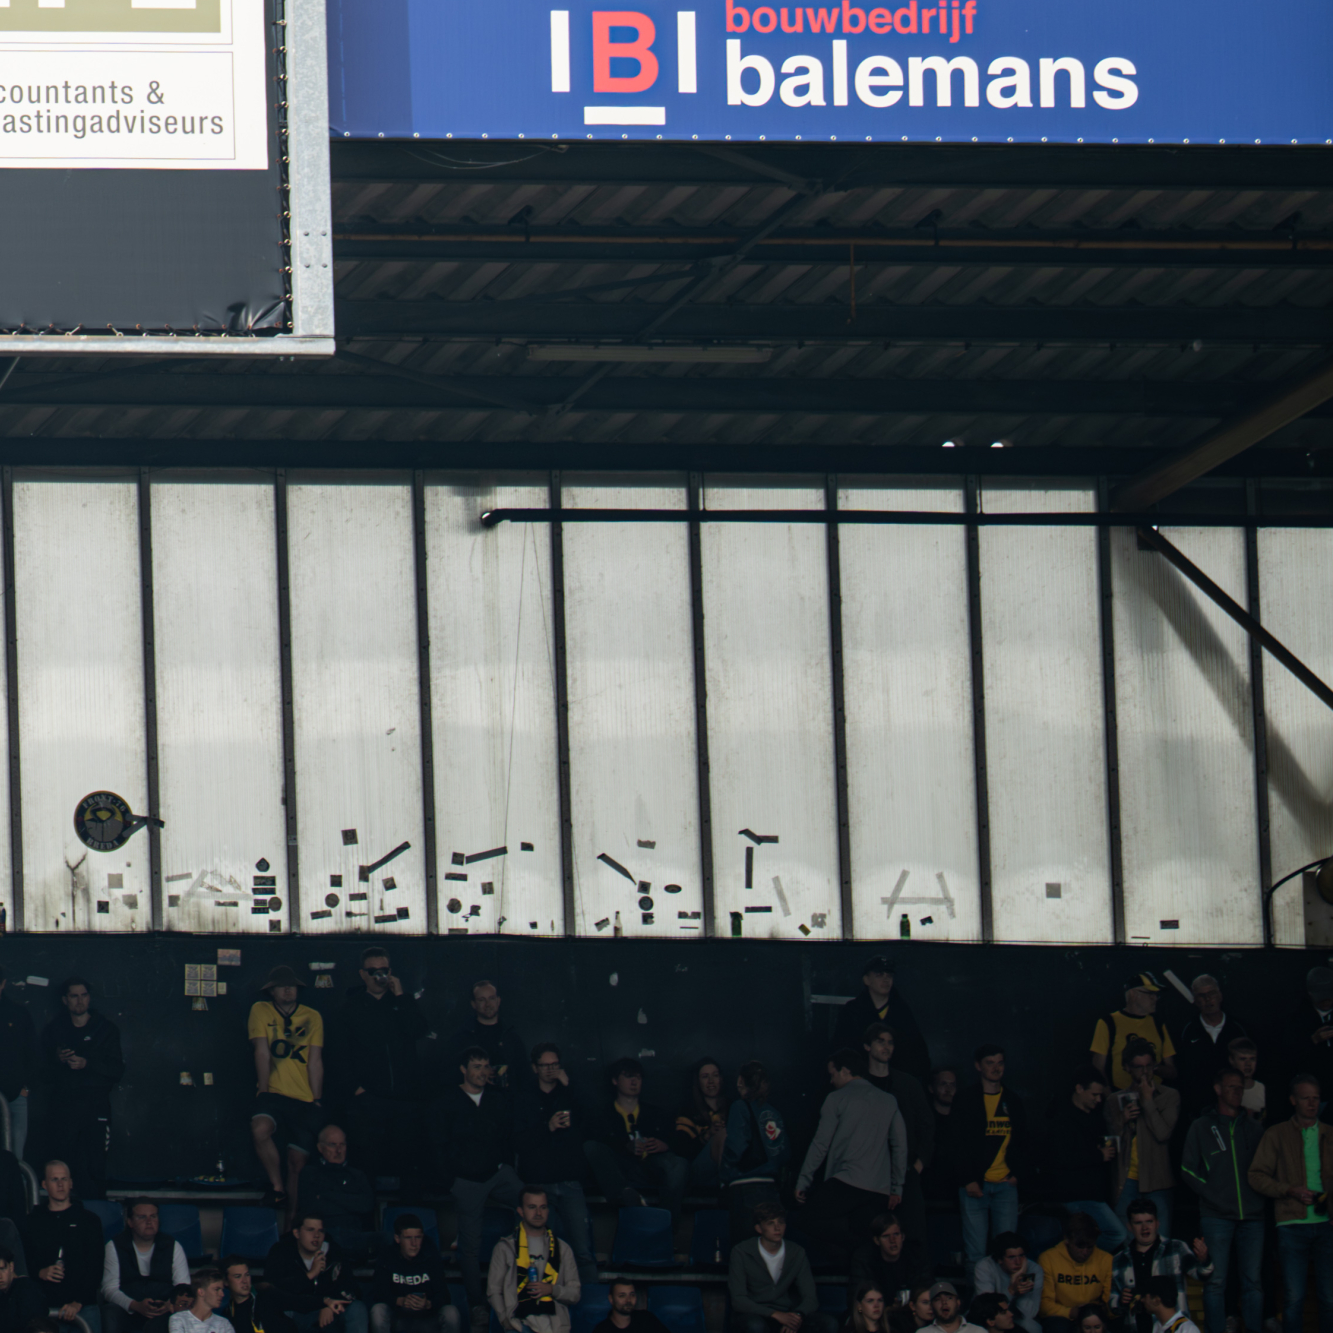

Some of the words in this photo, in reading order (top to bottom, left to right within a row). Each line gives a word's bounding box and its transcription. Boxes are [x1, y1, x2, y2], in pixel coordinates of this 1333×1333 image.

[725, 0, 977, 42] bouwbedrijf
[726, 39, 1139, 110] balemans
[146, 80, 165, 105] &
[271, 1039, 307, 1064] OK
[392, 1273, 430, 1286] BREDA
